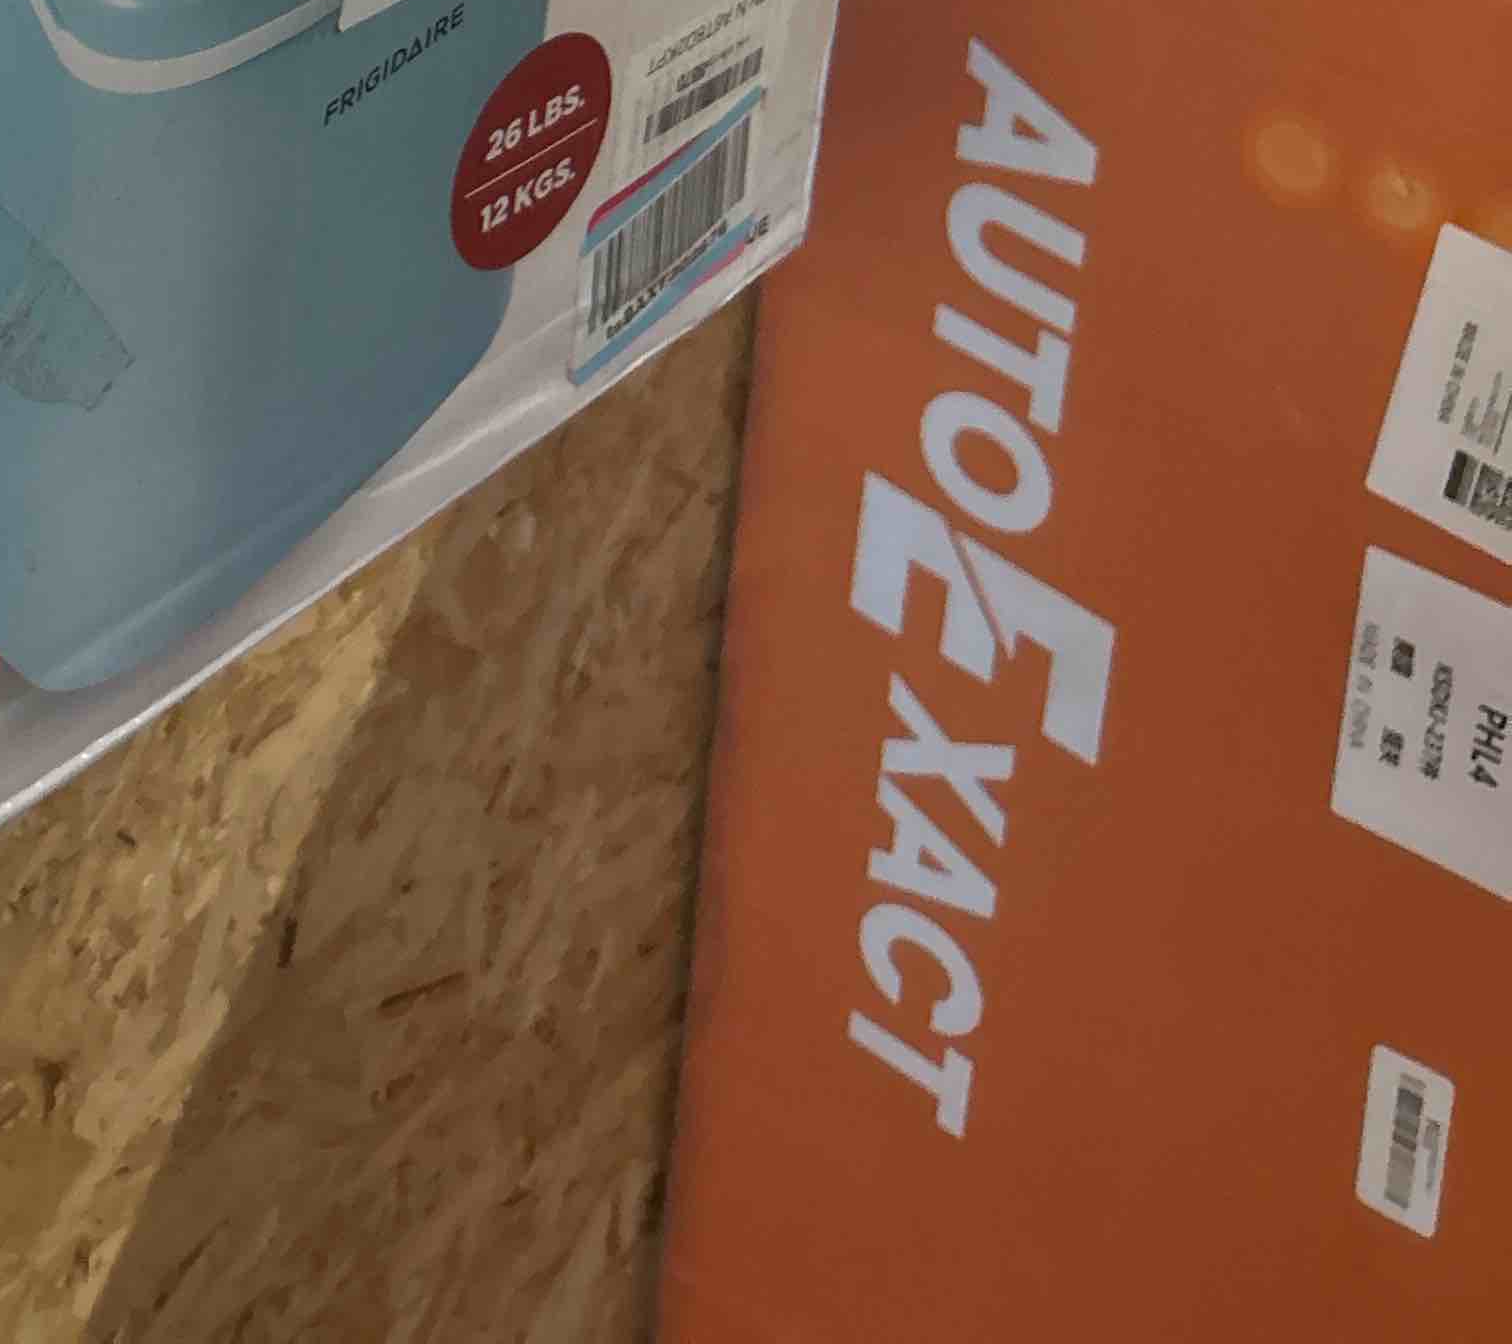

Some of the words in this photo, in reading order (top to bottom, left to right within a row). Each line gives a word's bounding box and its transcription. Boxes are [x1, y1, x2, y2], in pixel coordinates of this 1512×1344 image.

[322, 2, 467, 128] FRIGIDAIRE
[484, 117, 523, 163] 26
[527, 83, 587, 139] LBS.
[478, 193, 510, 234] 12
[512, 156, 578, 220] KGS.
[1467, 703, 1510, 789] PHL4
